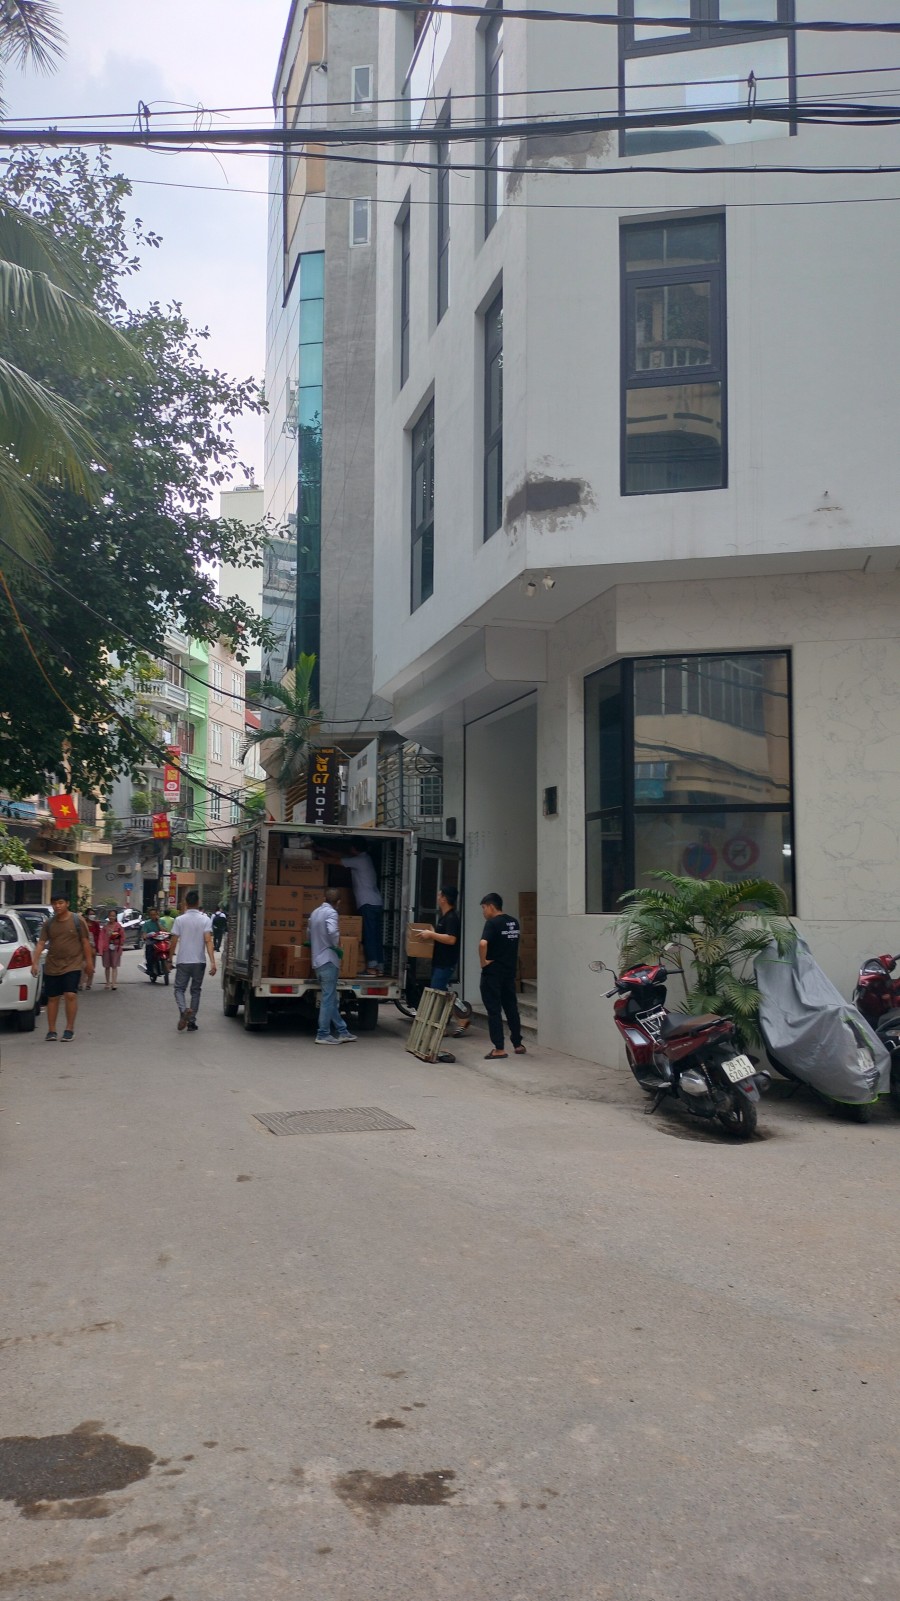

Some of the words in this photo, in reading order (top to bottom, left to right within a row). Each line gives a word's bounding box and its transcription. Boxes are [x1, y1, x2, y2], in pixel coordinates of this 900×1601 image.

[312, 773, 330, 784] G7
[726, 1058, 746, 1072] 29-Y1
[729, 1066, 753, 1081] 520.32
